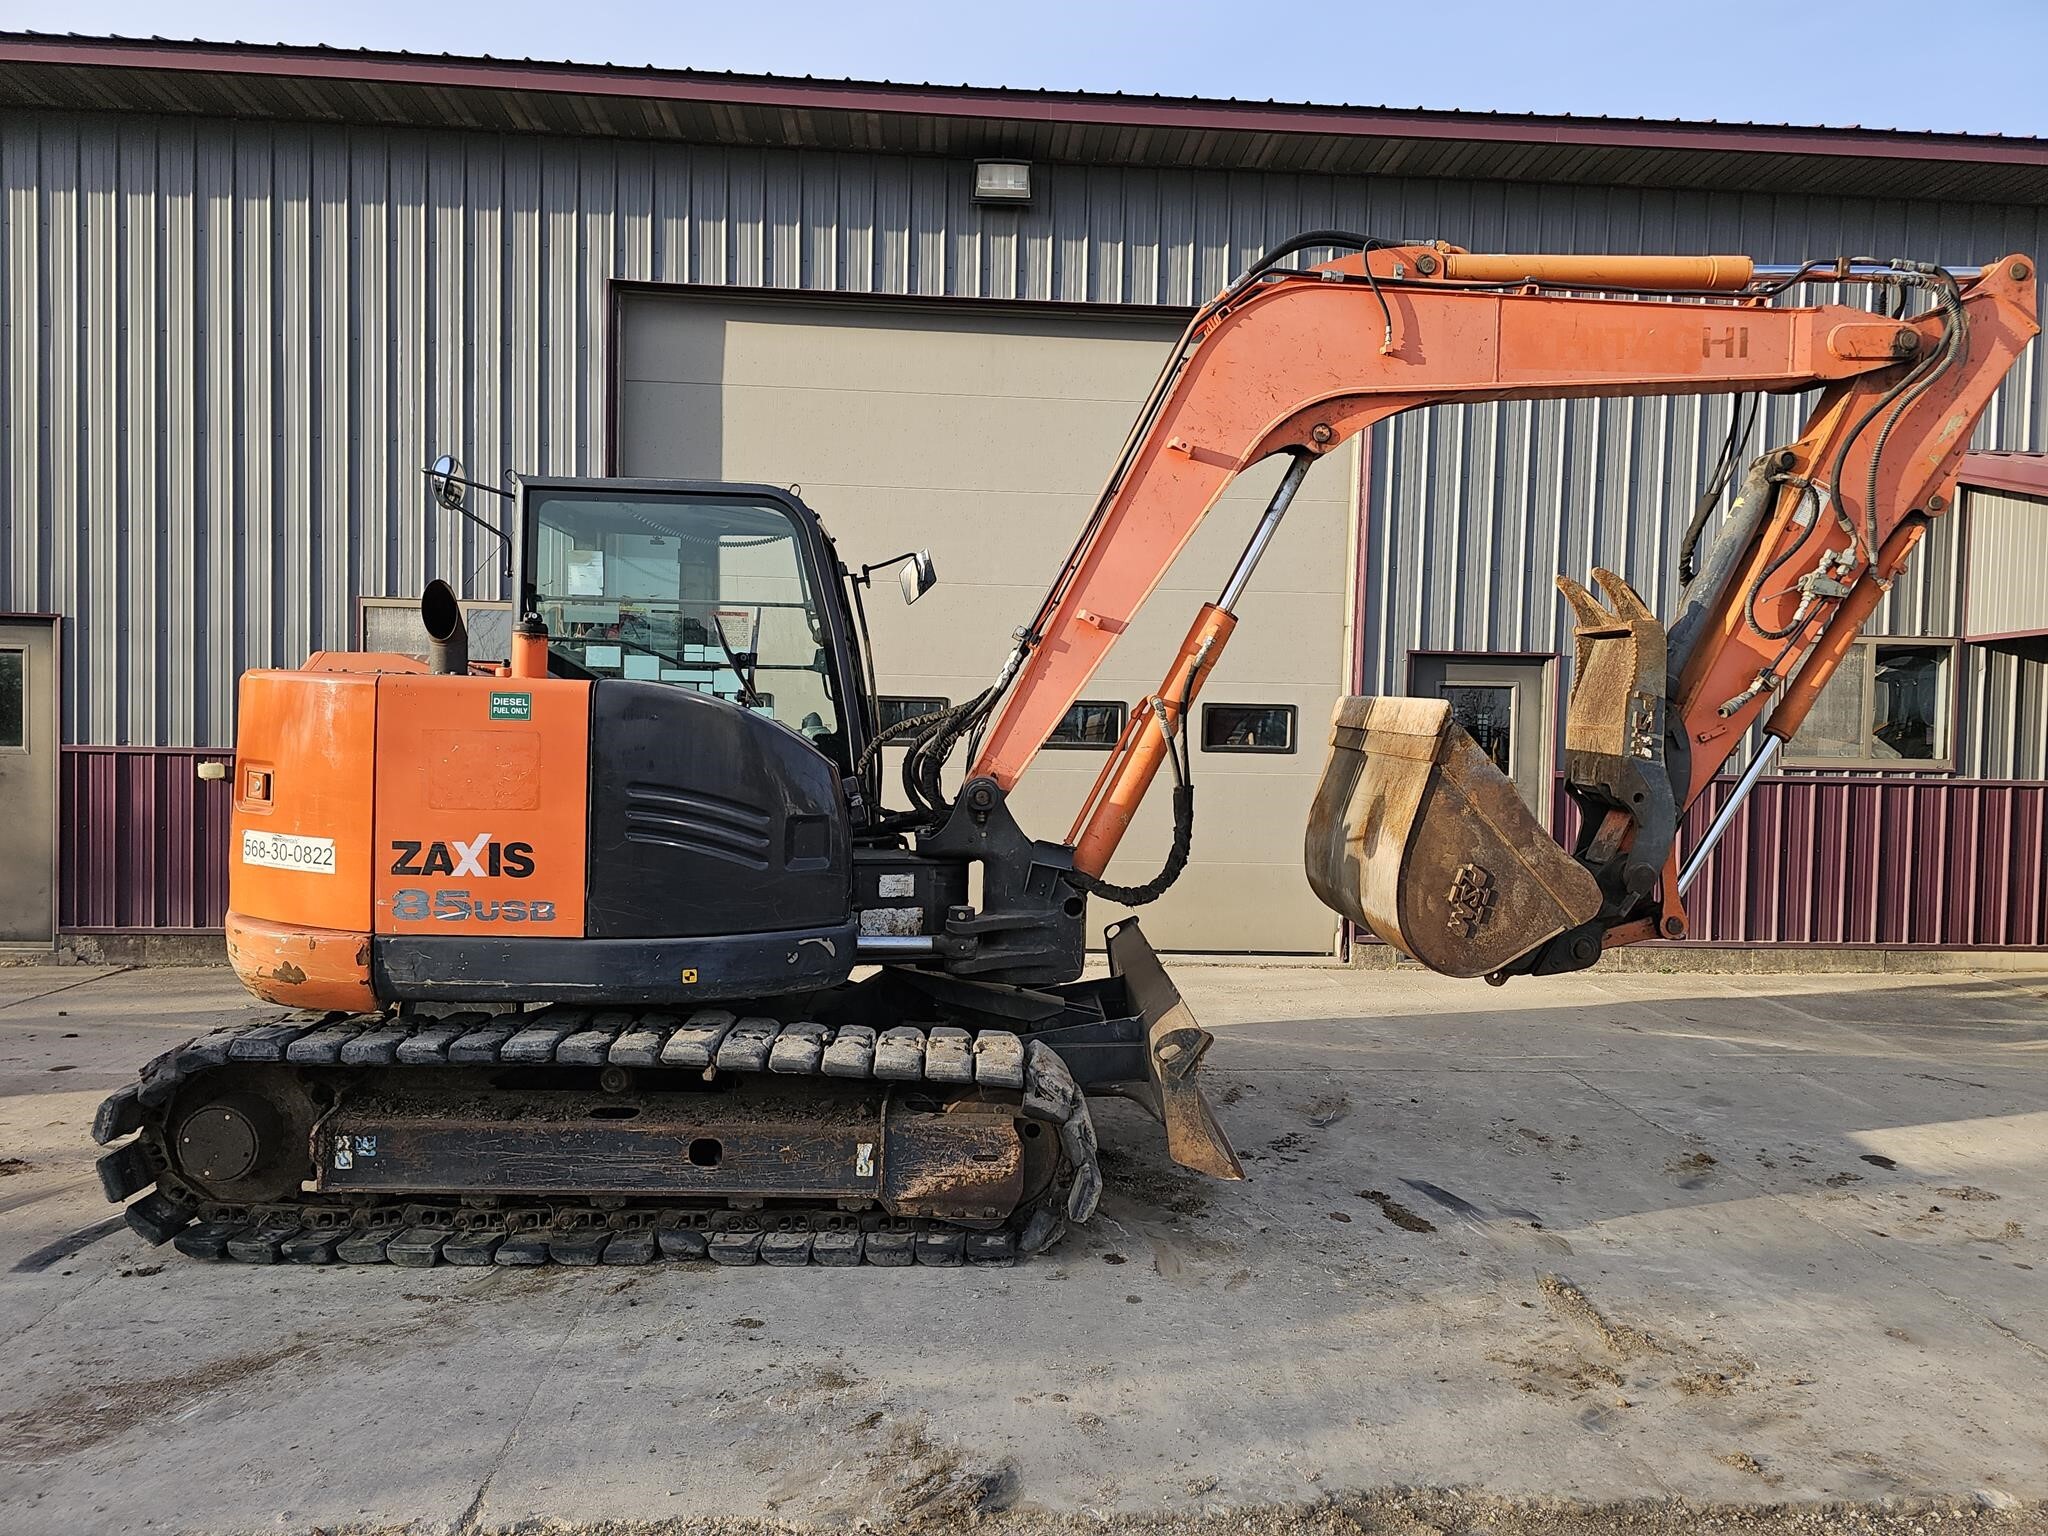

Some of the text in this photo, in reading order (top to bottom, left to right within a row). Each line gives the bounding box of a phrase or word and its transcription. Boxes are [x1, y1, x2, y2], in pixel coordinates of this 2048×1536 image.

[493, 697, 529, 706] DIESEL
[244, 838, 333, 866] 568-30-0822
[391, 833, 535, 878] ZAXIS
